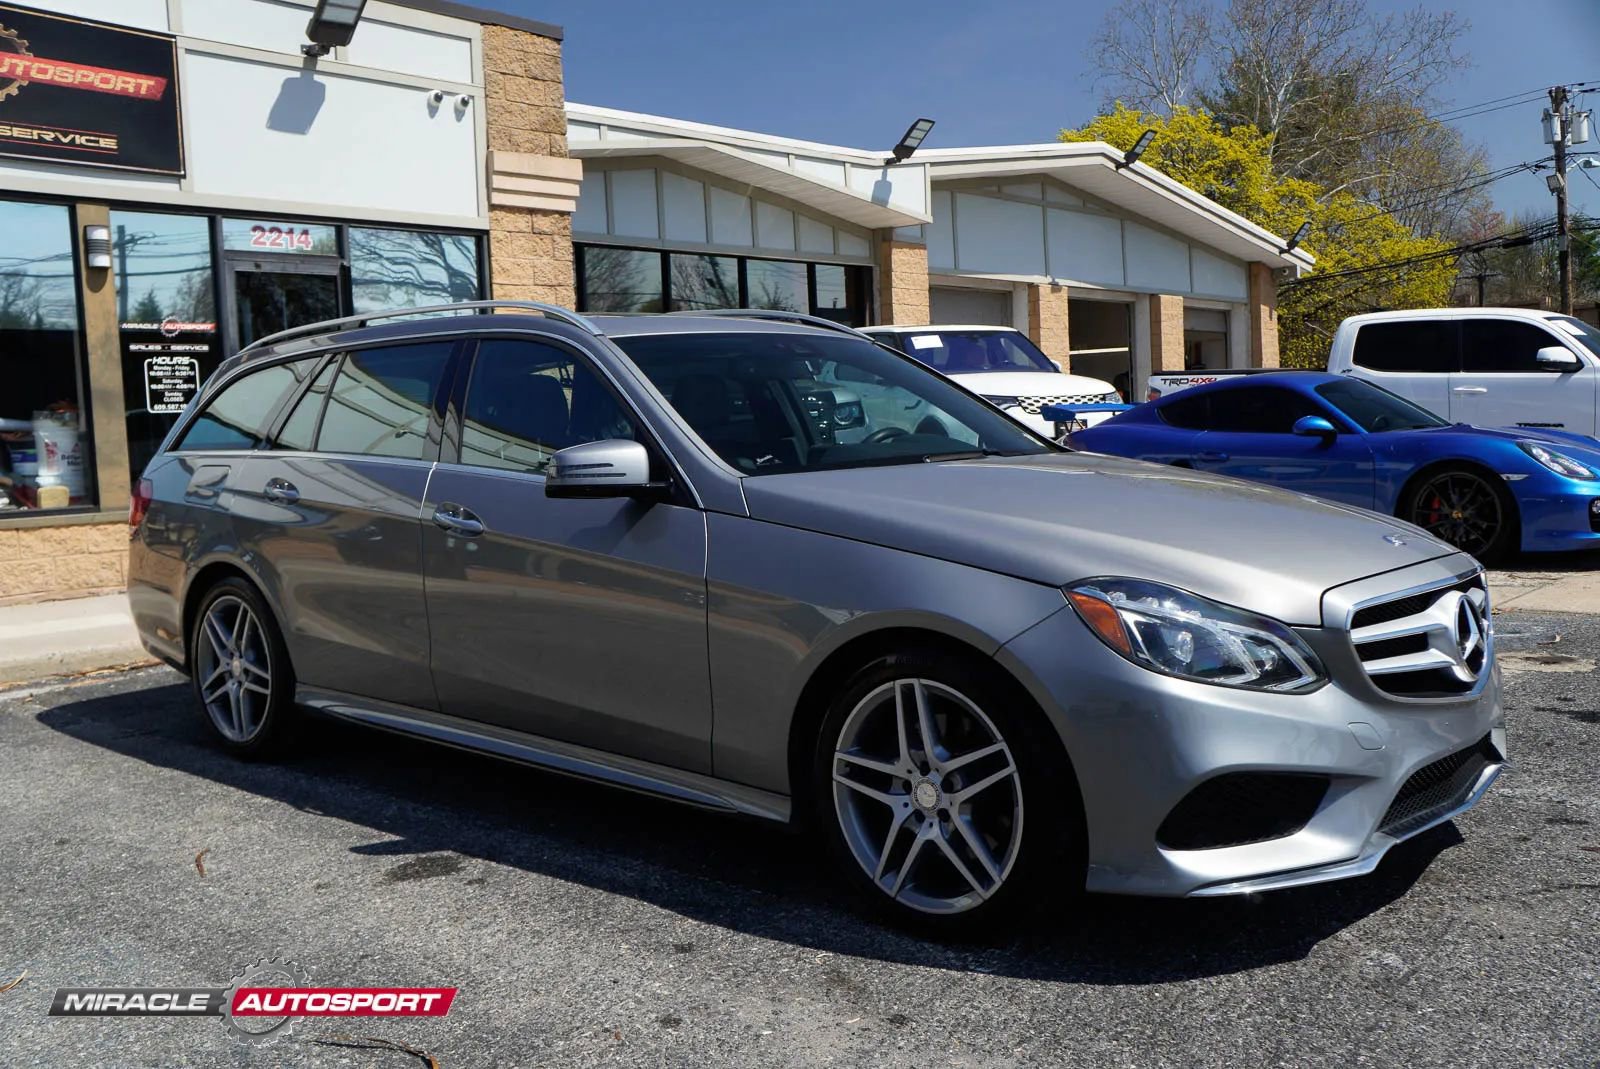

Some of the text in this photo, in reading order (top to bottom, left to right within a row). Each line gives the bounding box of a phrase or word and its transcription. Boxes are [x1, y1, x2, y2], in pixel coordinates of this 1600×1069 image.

[0, 125, 119, 149] SERVICE
[251, 225, 312, 249] 2214
[152, 356, 190, 365] HOURS
[1160, 377, 1189, 386] TRD
